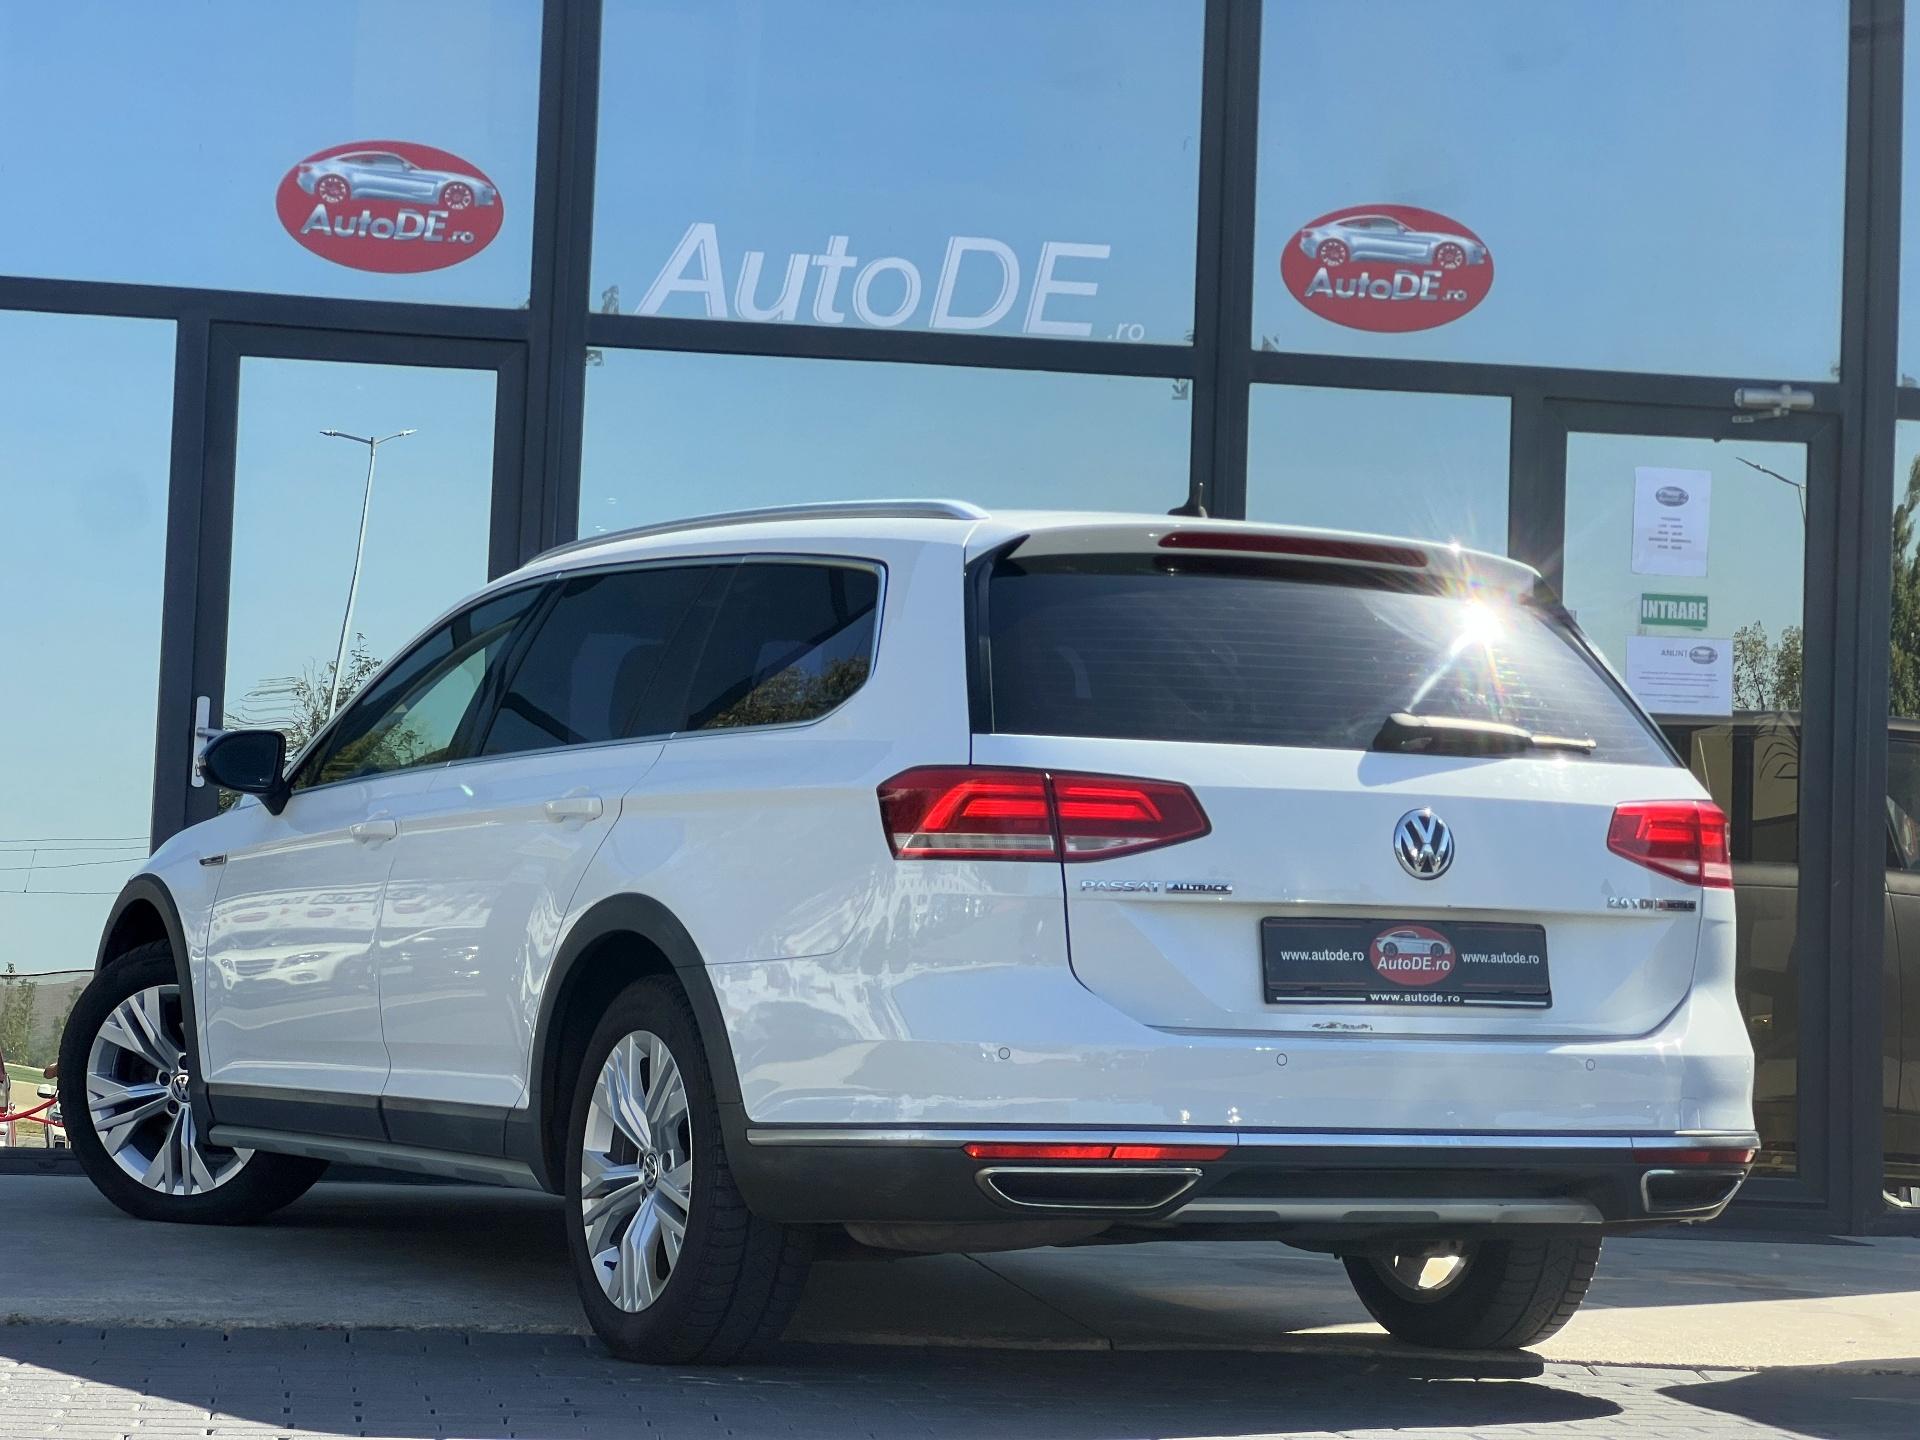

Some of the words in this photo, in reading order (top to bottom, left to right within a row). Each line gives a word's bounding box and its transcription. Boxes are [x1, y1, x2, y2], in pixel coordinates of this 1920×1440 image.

[1642, 599, 1708, 621] INTRARE
[1080, 880, 1161, 892] PASSAT
[1171, 883, 1229, 892] ALLTRACK
[1281, 949, 1365, 962] www.autode.ro
[1377, 956, 1451, 971] AutoDE.ro
[1461, 951, 1540, 965] www.autode.ro
[1370, 992, 1460, 1003] www.autode.ro
